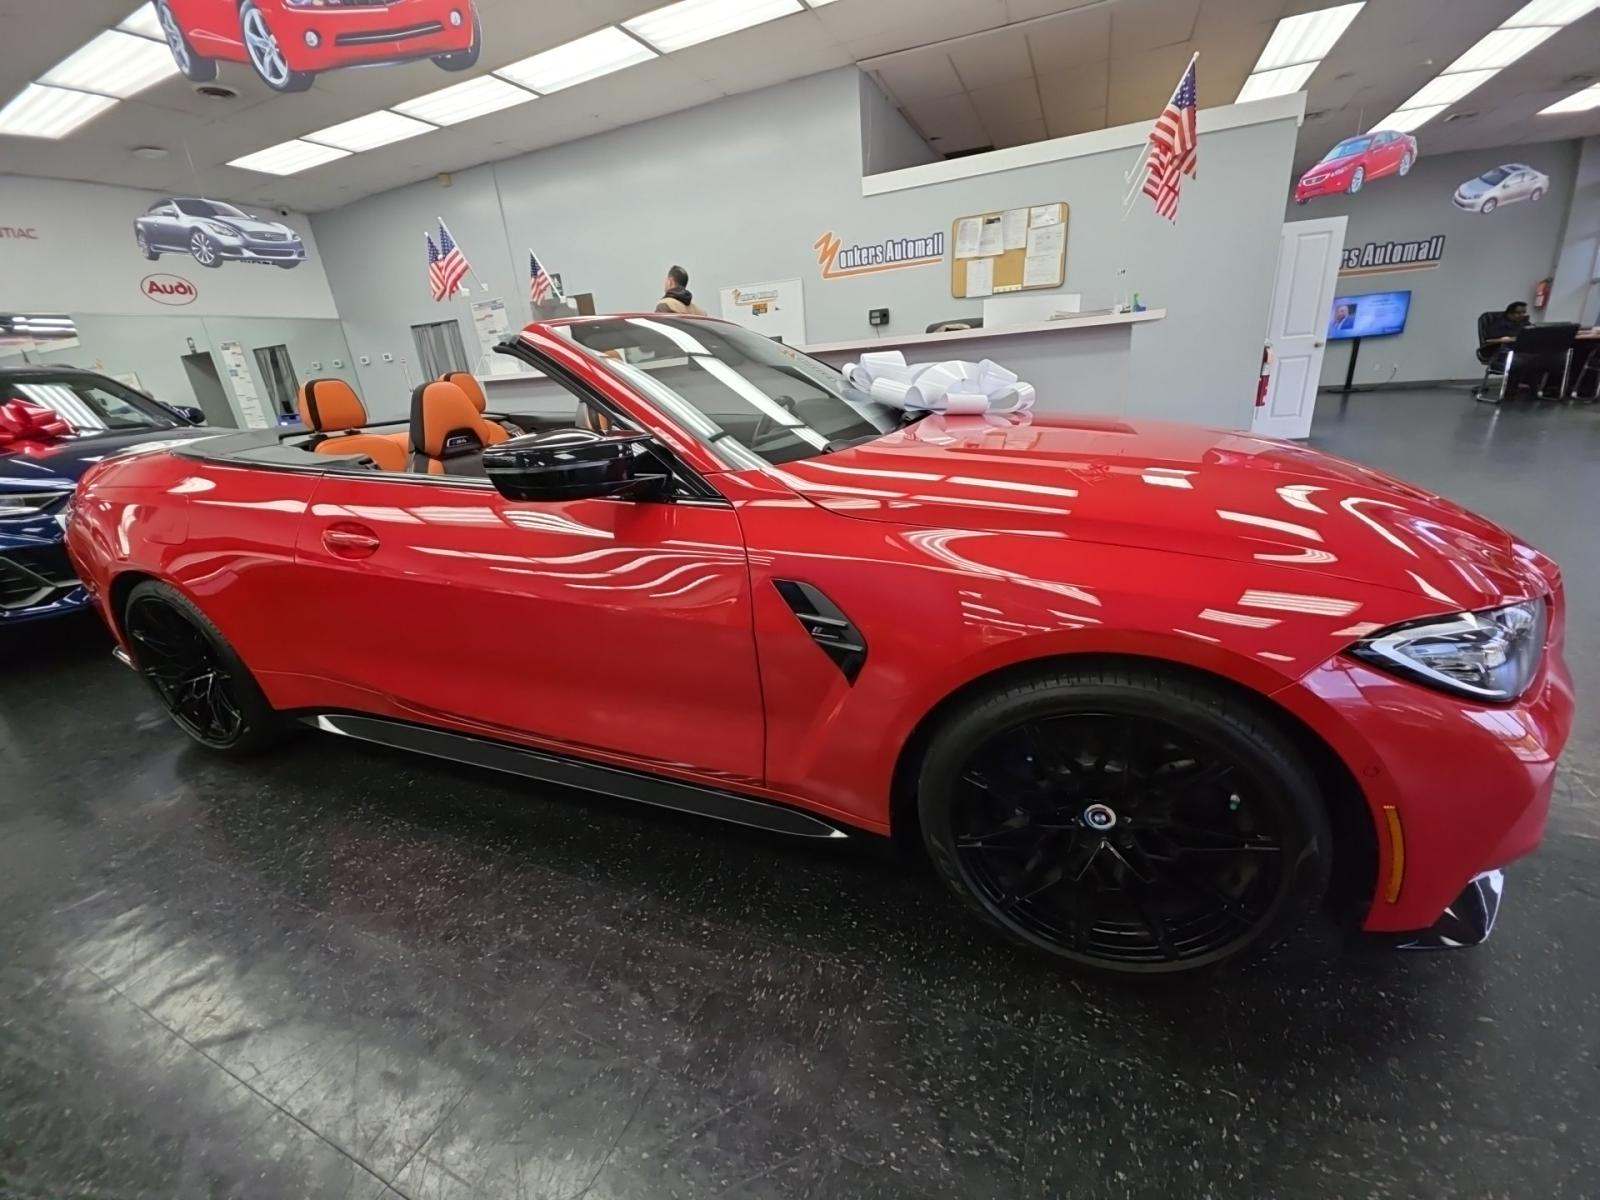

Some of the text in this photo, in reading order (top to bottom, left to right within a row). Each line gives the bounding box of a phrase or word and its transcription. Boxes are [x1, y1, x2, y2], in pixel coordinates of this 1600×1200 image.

[885, 232, 943, 263] Automall
[1360, 235, 1446, 267] Automall
[147, 280, 193, 296] Audi
